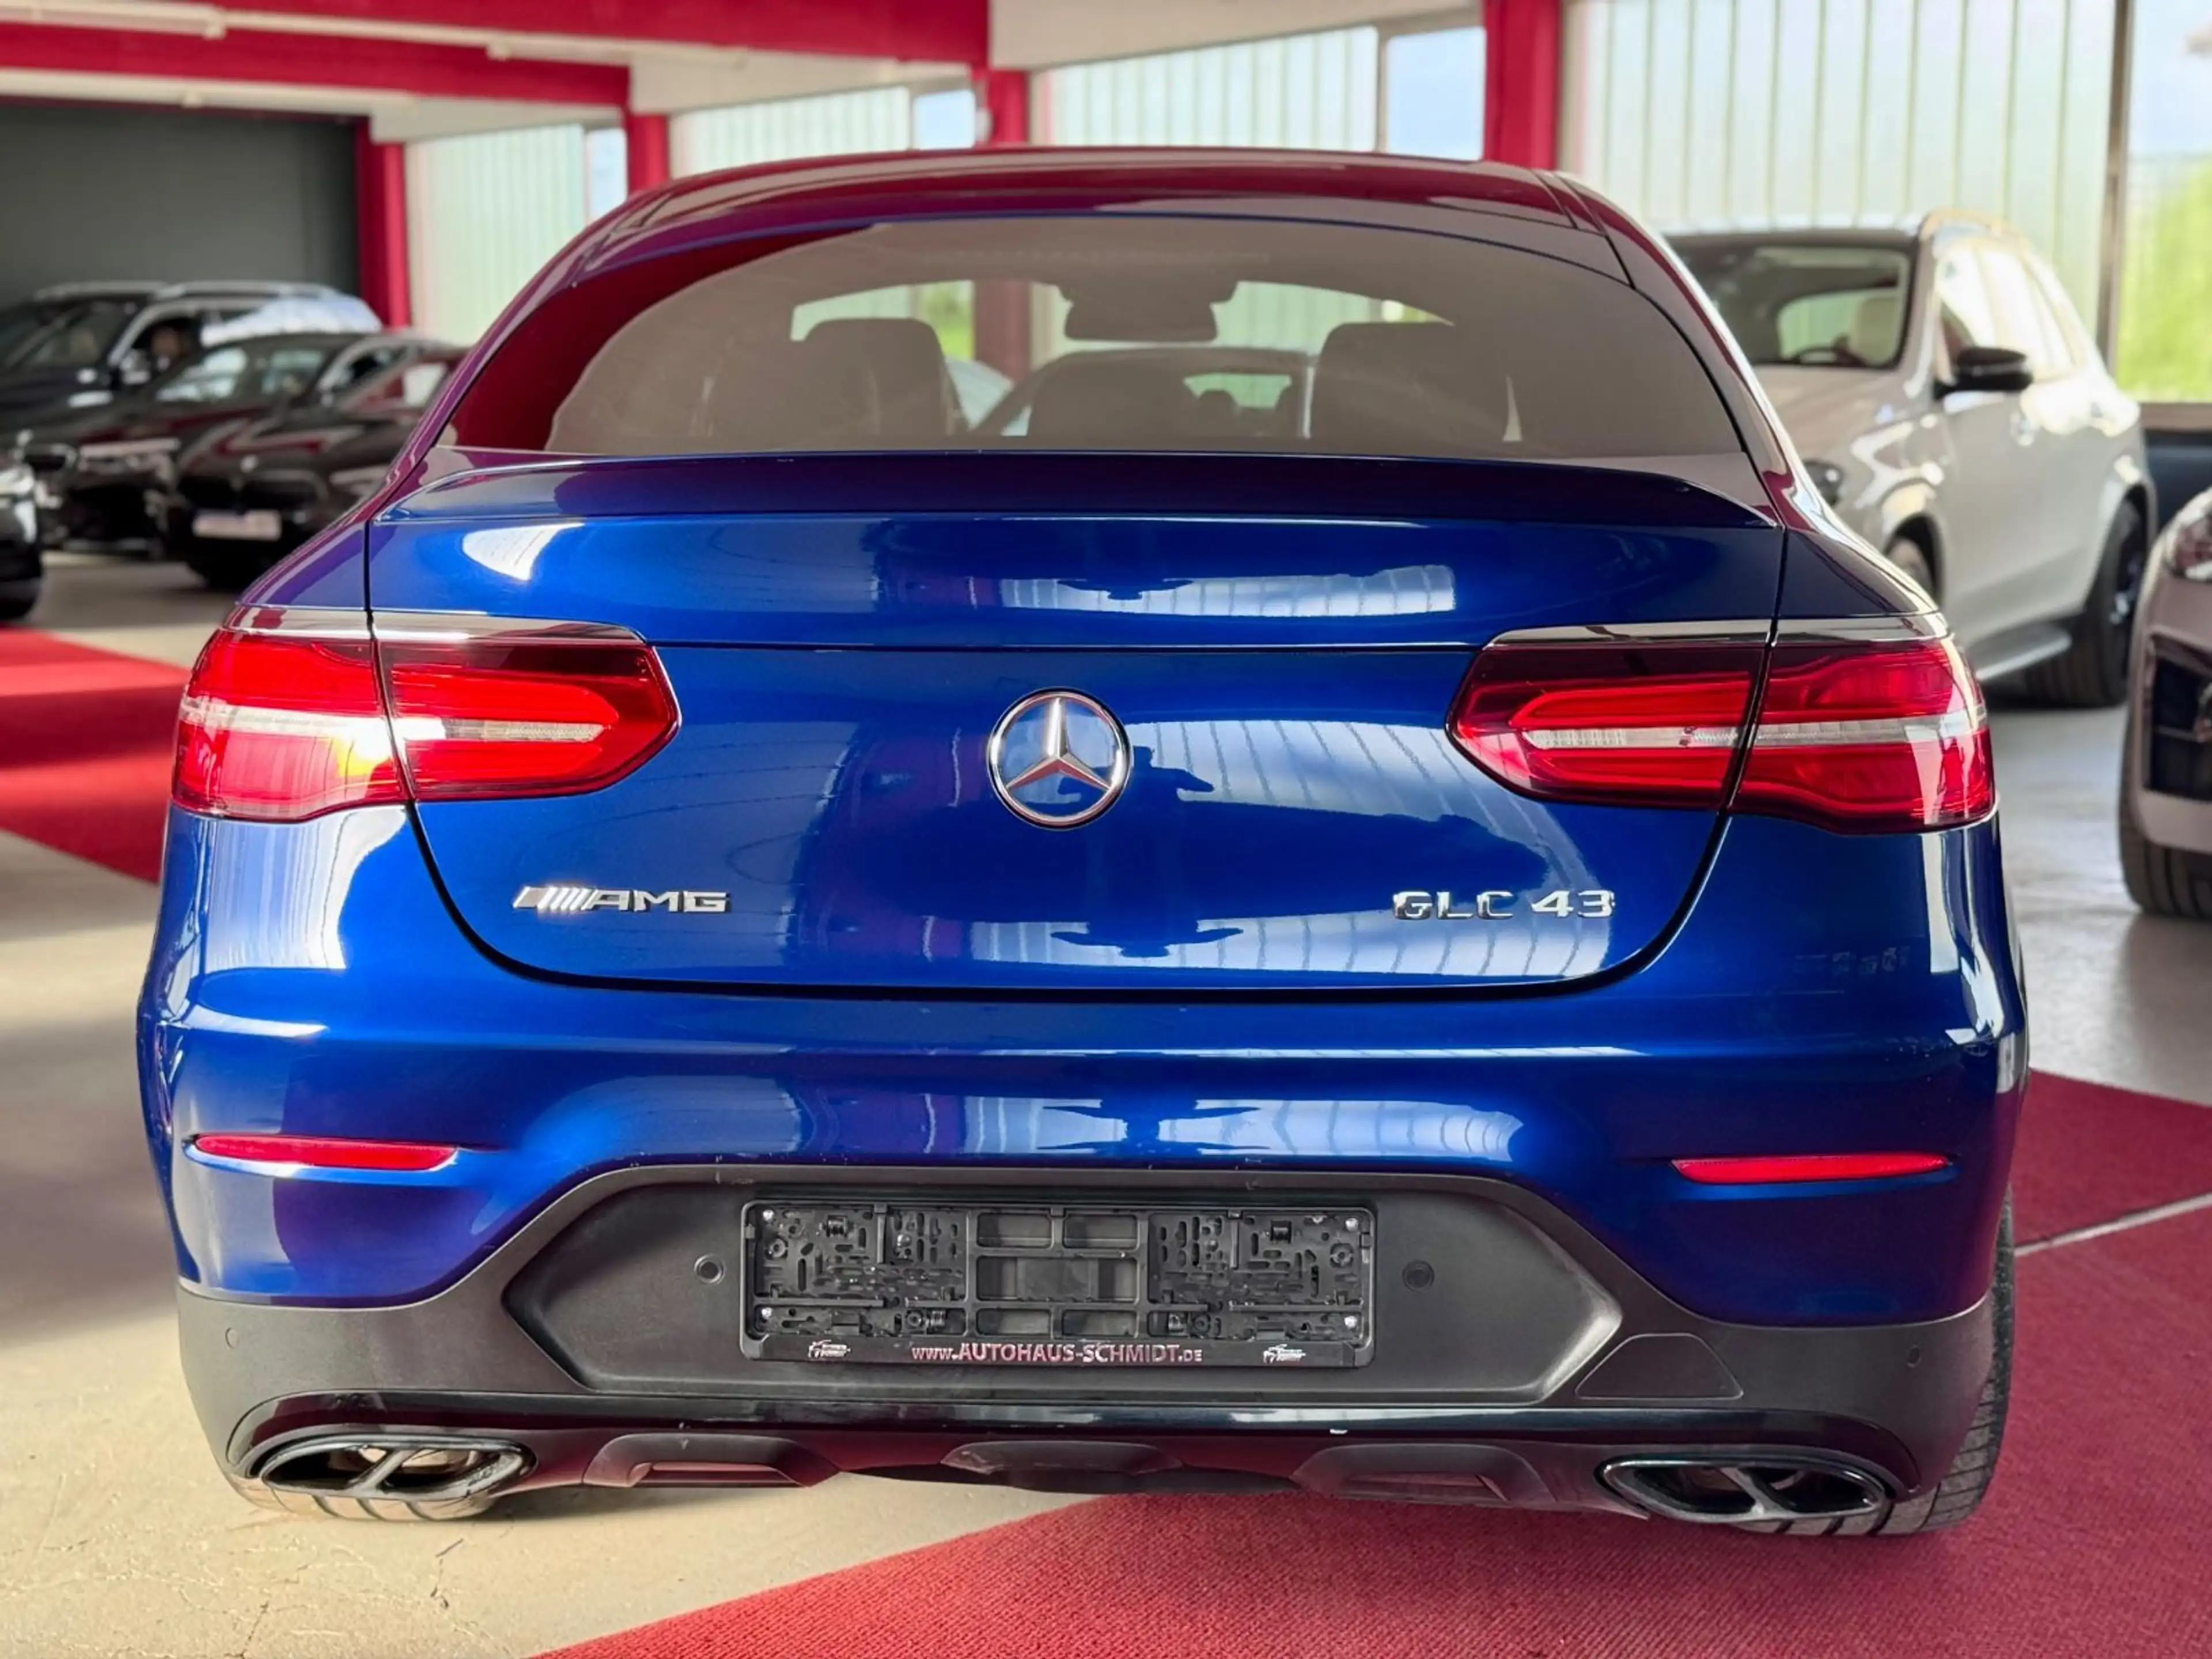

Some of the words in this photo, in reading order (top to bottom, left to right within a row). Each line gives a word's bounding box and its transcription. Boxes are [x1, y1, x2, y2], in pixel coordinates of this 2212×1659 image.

[581, 889, 728, 912] AMG
[1392, 891, 1514, 919] GLC
[1531, 890, 1616, 918] 43
